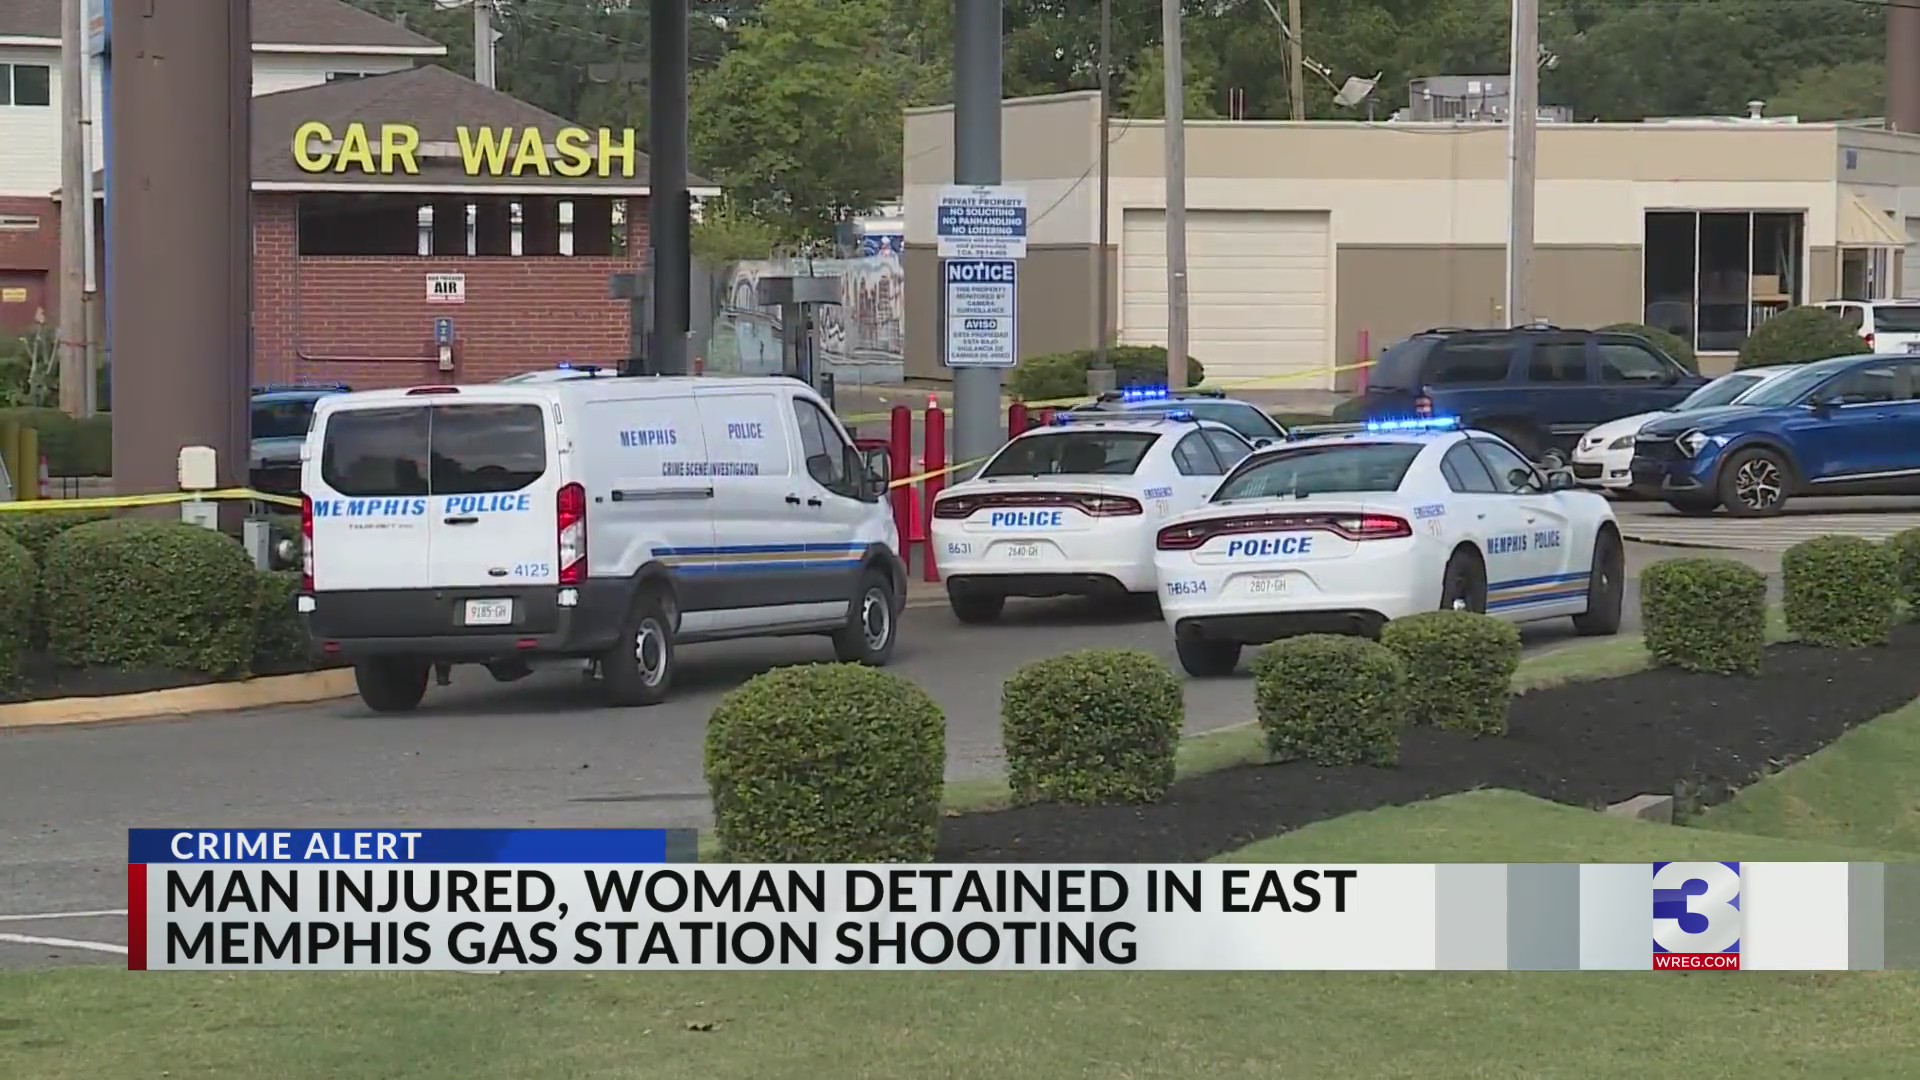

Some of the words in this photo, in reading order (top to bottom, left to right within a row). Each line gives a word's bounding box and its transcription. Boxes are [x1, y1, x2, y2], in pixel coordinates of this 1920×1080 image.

[293, 121, 420, 174] CAR
[456, 126, 636, 178] WASH
[942, 197, 976, 205] PRIVATE
[979, 198, 1022, 206] PROPERTY
[949, 207, 964, 216] NO
[965, 208, 1016, 217] SOLICITING
[942, 217, 957, 225] NO
[958, 217, 1022, 226] PANHANDLING
[951, 227, 966, 235] NO
[967, 227, 1013, 235] LOITERING
[948, 264, 1014, 281] NOTICE
[434, 281, 457, 294] AIR
[966, 320, 997, 329] AVISO
[620, 428, 677, 447] MEMPHIS
[727, 422, 764, 440] POLICE
[661, 461, 684, 476] CRIME
[685, 461, 709, 476] SCENE
[709, 461, 760, 476] INVESTIGATION
[313, 499, 427, 518] MEMPHIS
[445, 493, 532, 514] POLICE
[991, 510, 1064, 527] POLICE
[1227, 536, 1314, 557] POLICE
[1487, 535, 1528, 554] MEMPHIS
[1533, 529, 1561, 549] POLICE
[513, 563, 550, 577] 4125
